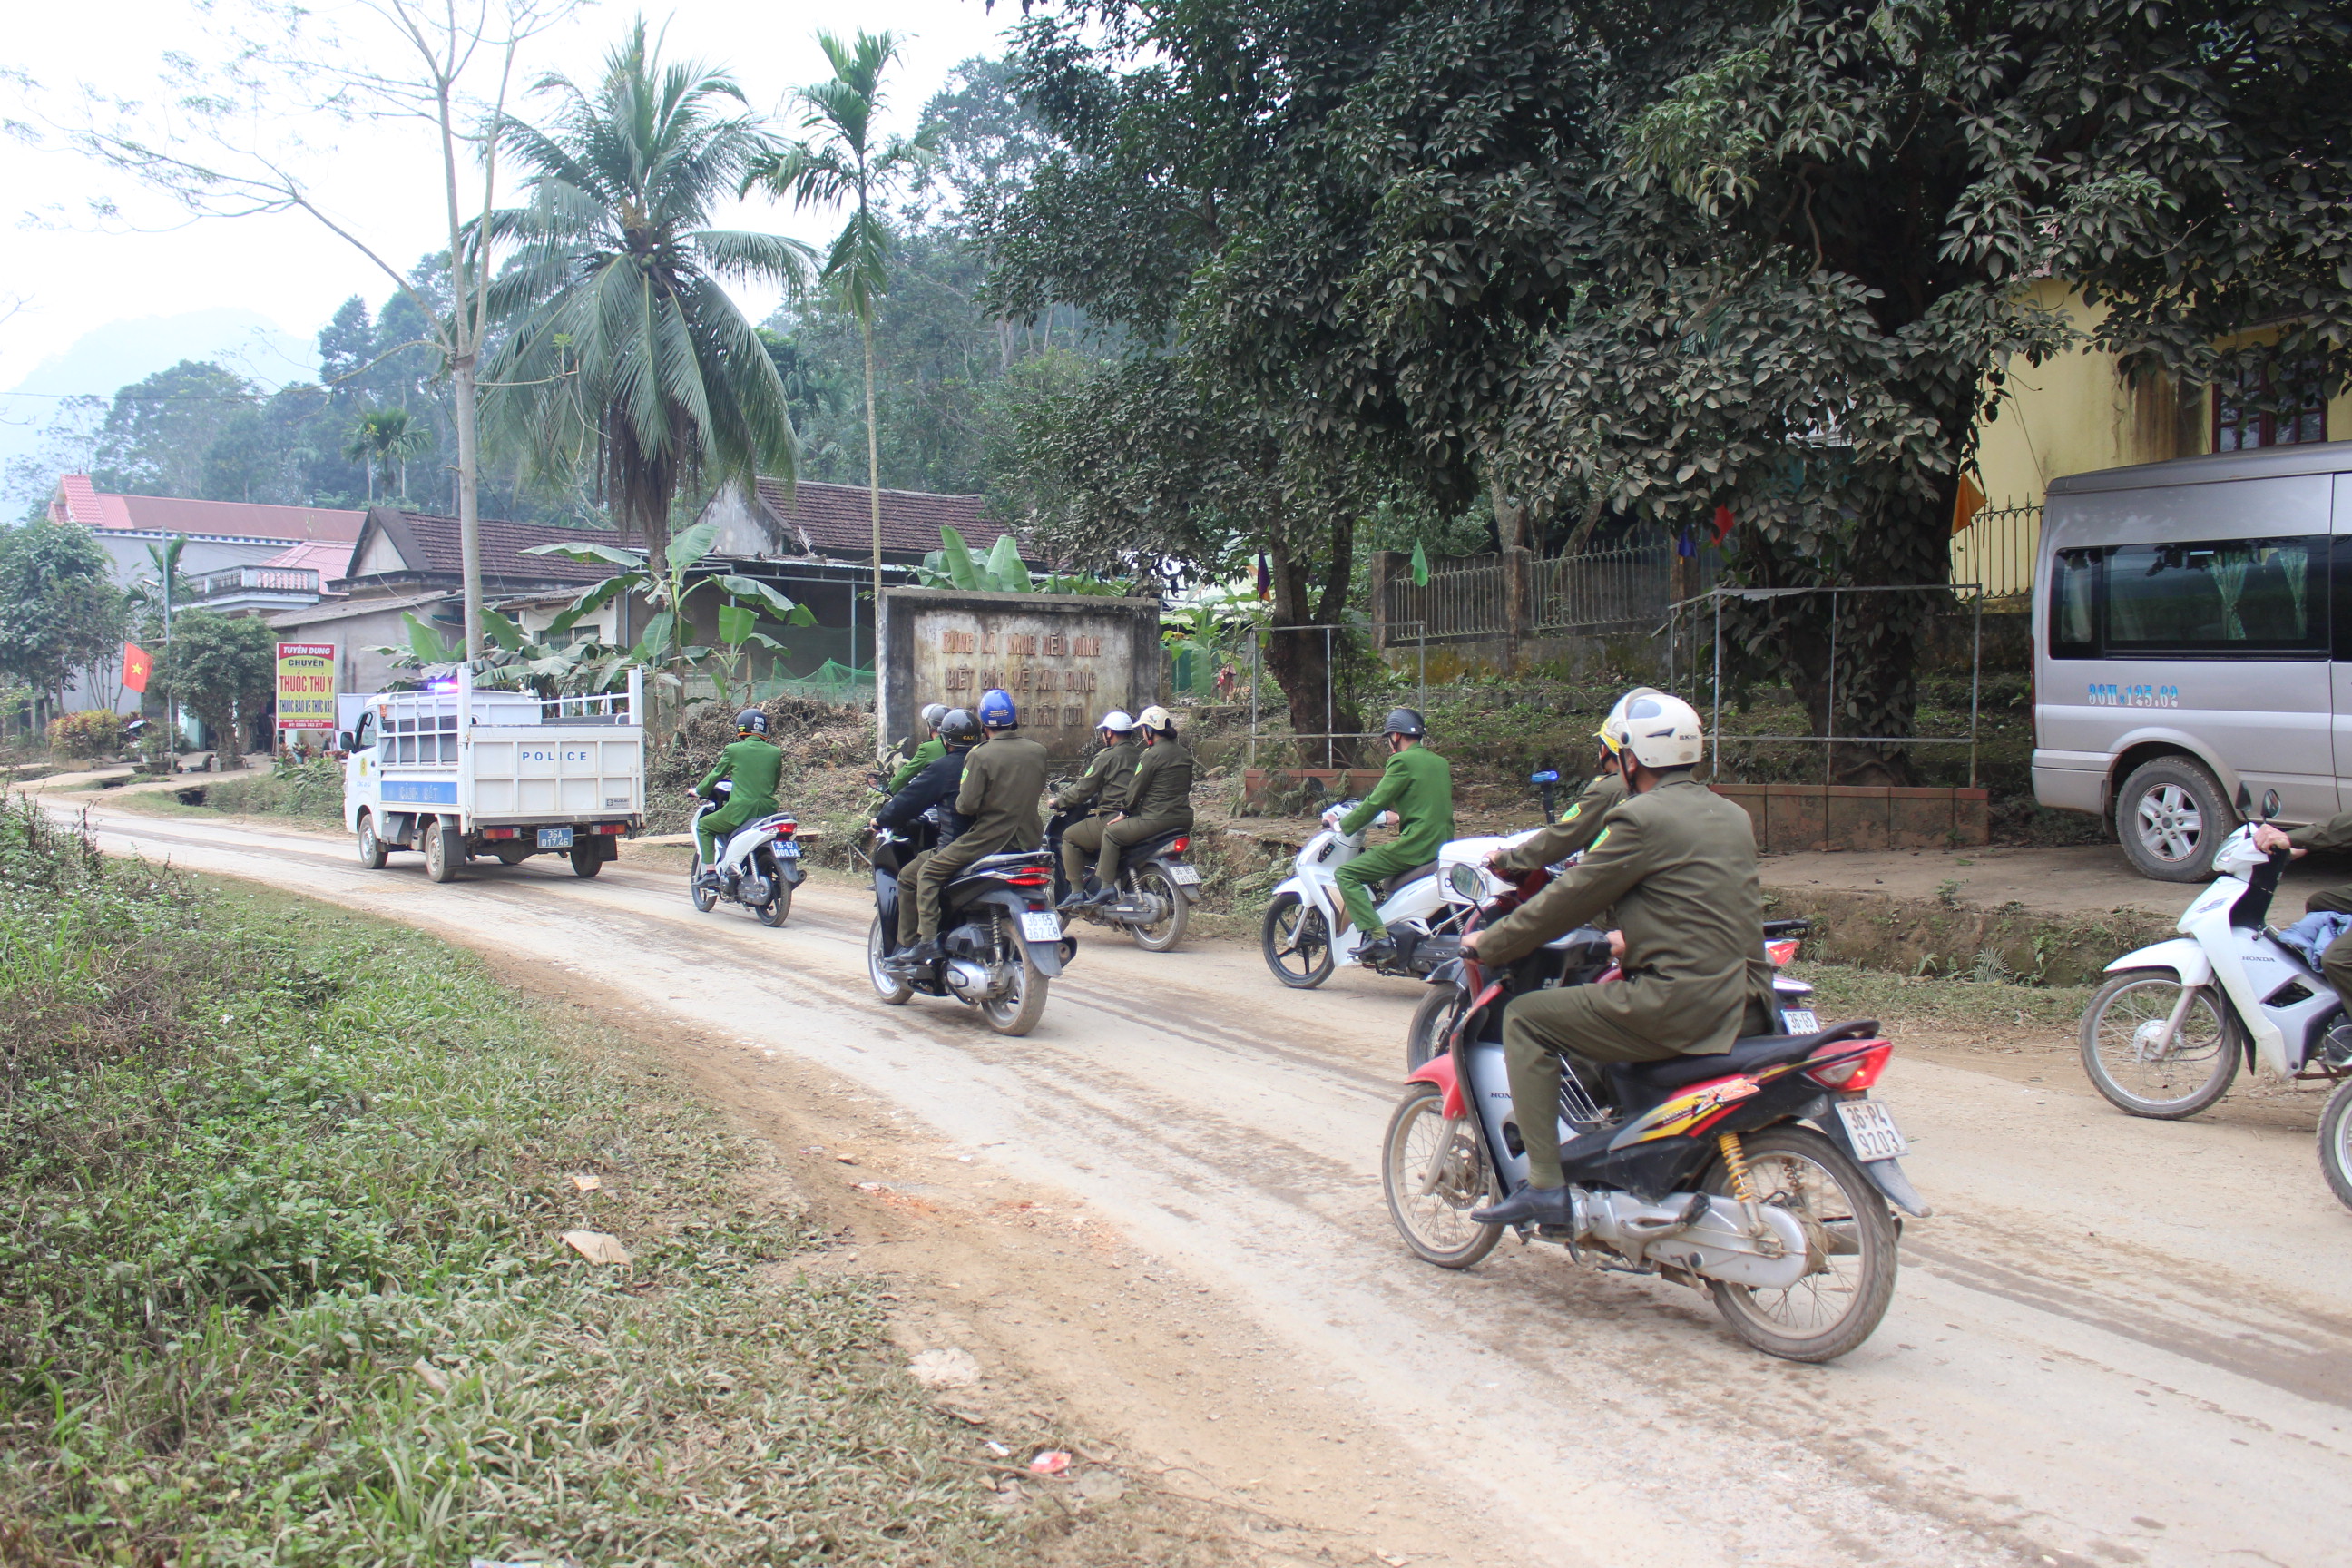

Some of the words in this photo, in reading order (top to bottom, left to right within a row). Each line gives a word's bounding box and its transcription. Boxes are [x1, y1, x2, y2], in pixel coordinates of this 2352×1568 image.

[288, 658, 324, 667] CHUYÊN
[279, 669, 308, 692] THUỐC
[309, 671, 326, 692] THÚ
[328, 676, 333, 692] Y
[522, 751, 587, 761] POLICE
[547, 830, 563, 838] 36A
[541, 838, 569, 848] 017.46
[1027, 914, 1053, 926] 36-G5
[1027, 926, 1060, 940] 362.48
[1857, 1129, 1900, 1156] 9203
